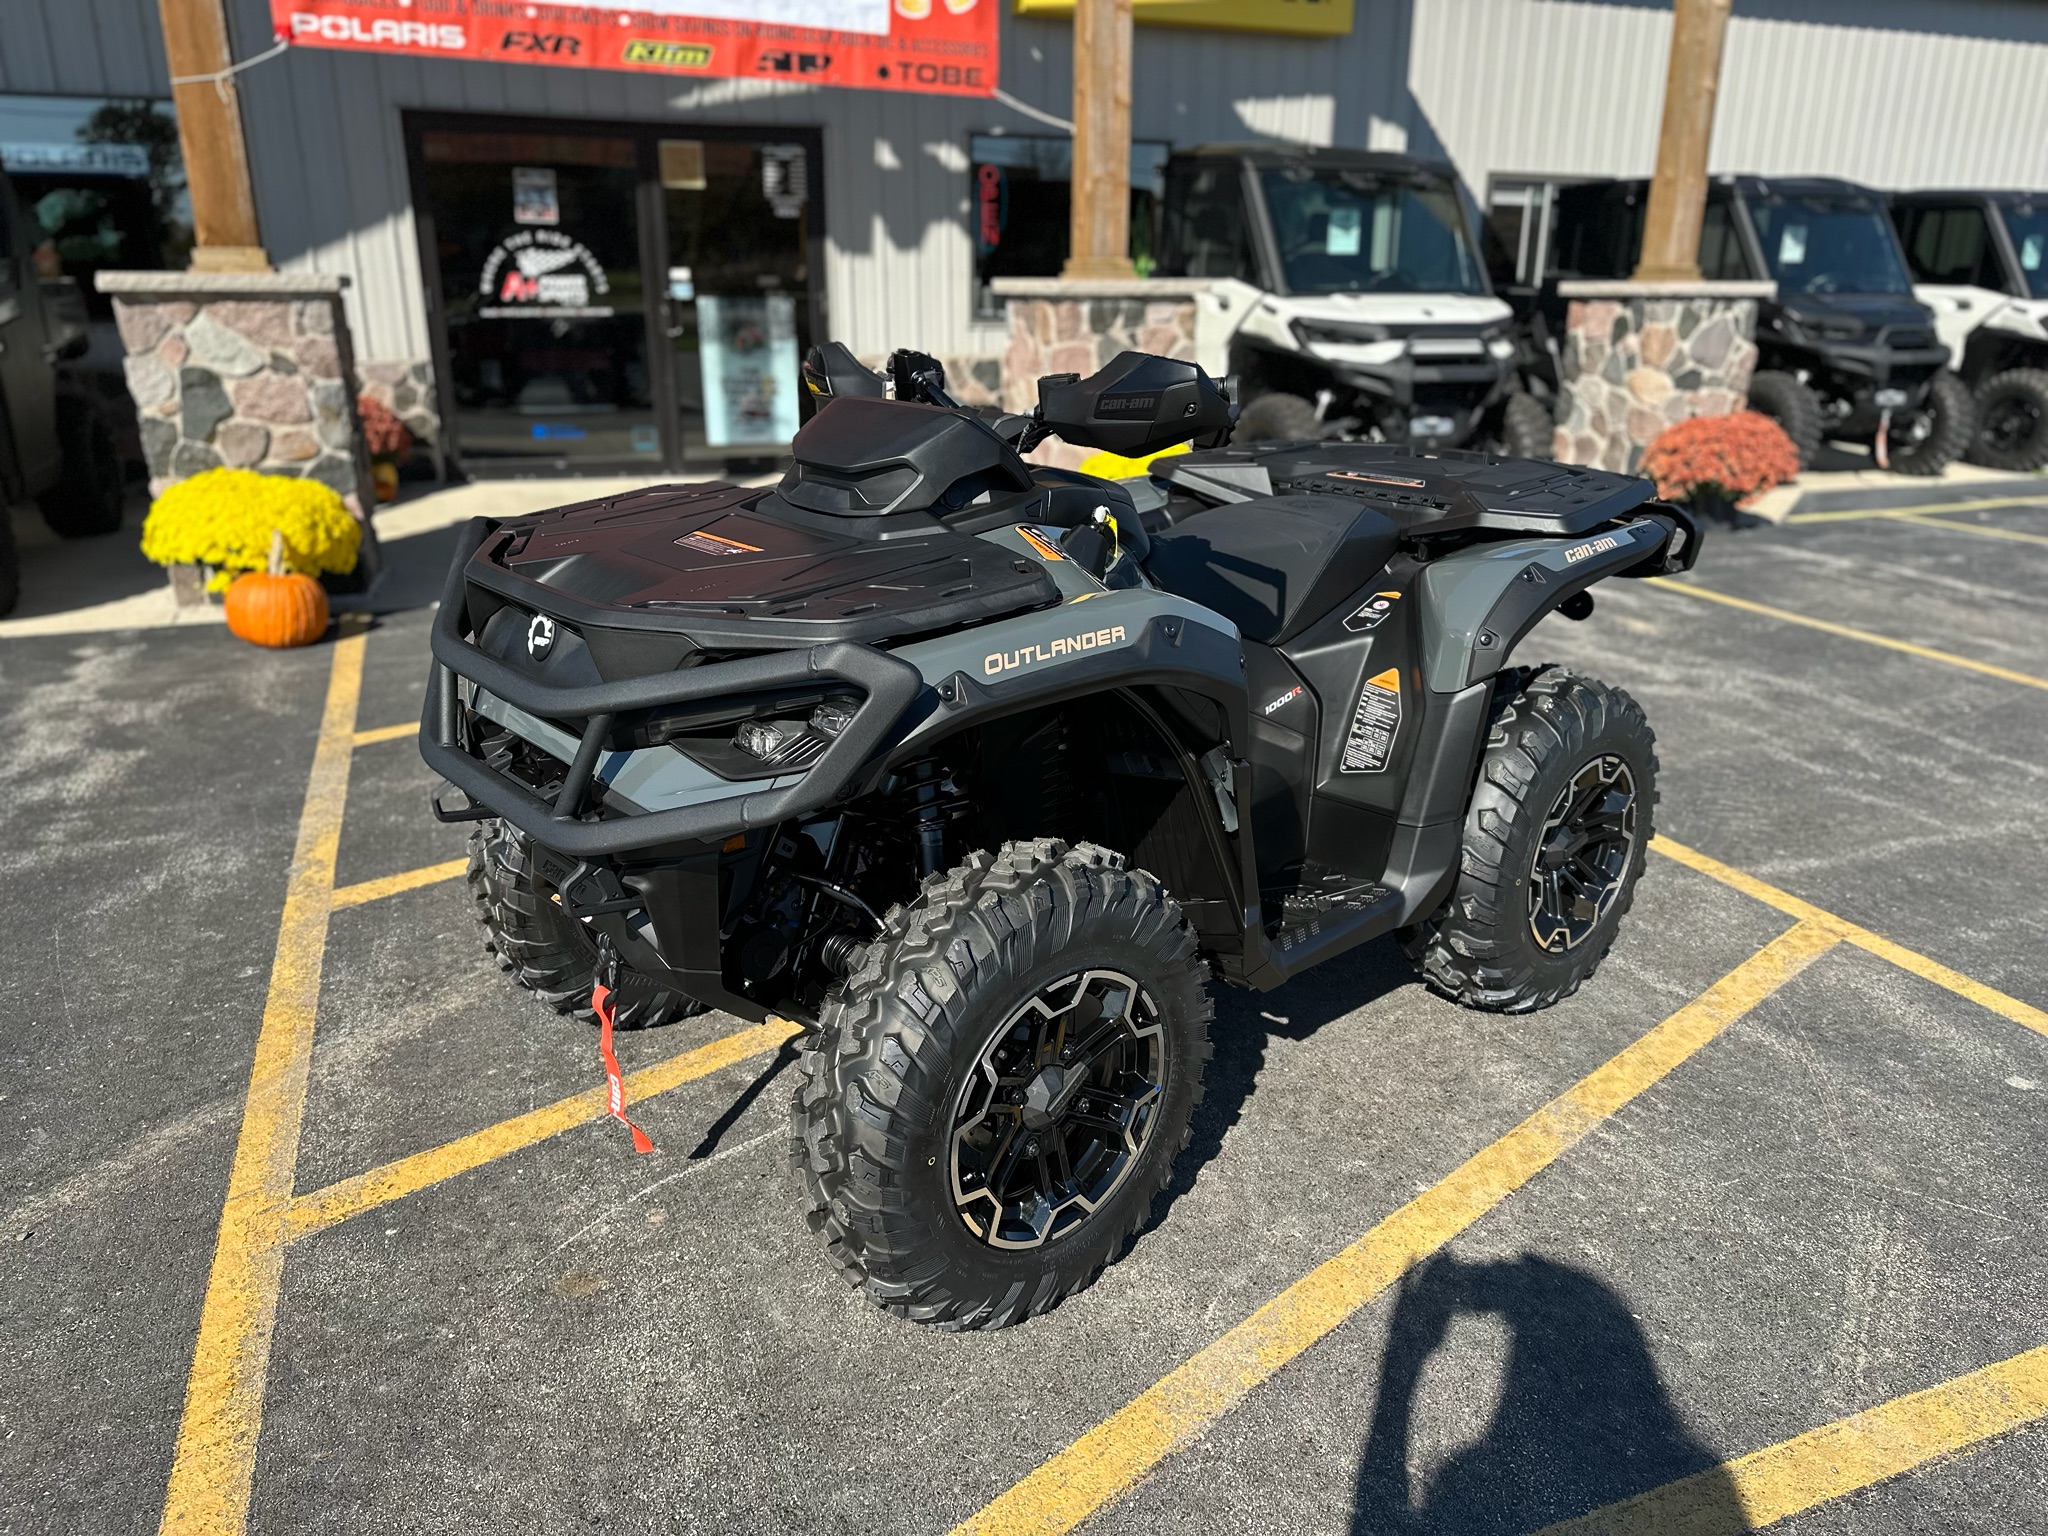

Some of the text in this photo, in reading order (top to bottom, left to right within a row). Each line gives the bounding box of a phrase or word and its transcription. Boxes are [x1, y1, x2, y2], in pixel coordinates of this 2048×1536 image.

[290, 12, 467, 50] POLARIS
[502, 31, 581, 55] FXR
[897, 61, 984, 88] TOBE
[1100, 397, 1155, 410] can-am
[1564, 536, 1618, 563] can-am
[984, 625, 1126, 676] OUTLANDER
[1264, 686, 1302, 715] 1000R
